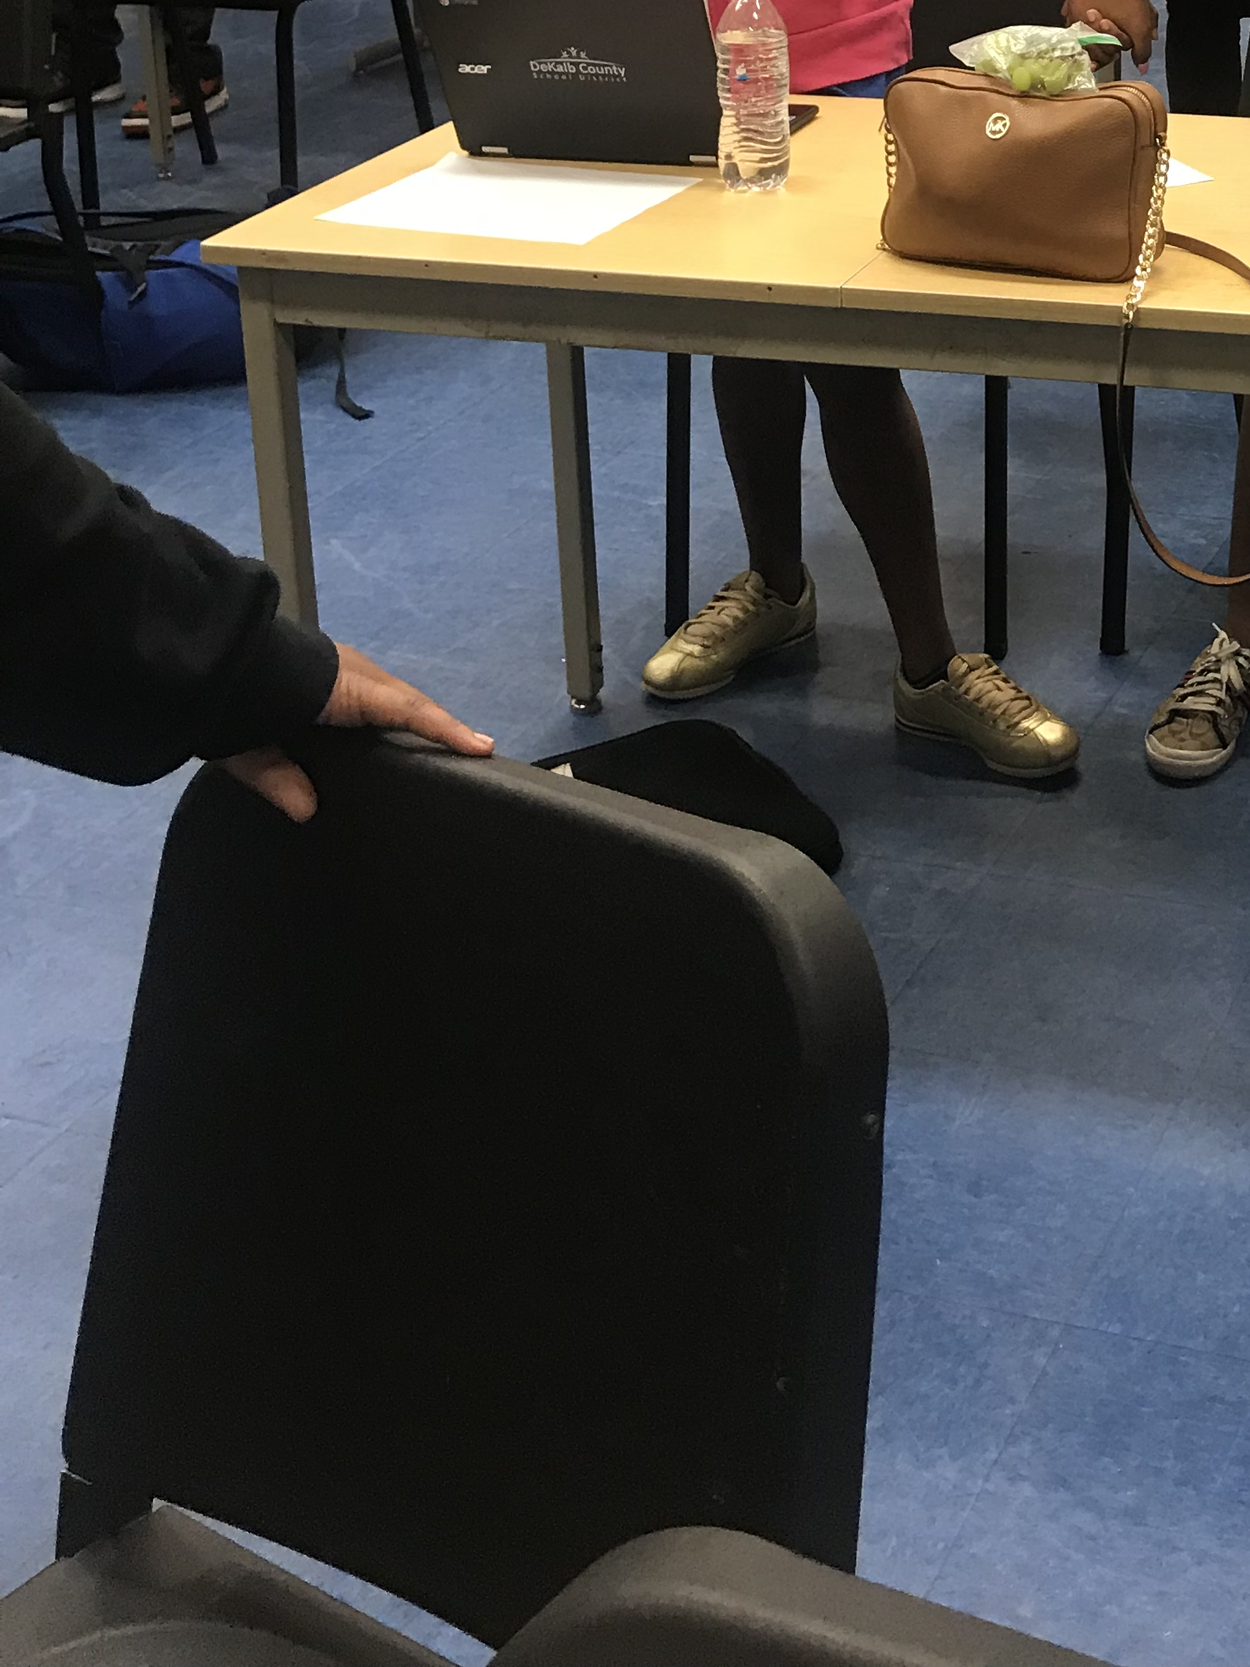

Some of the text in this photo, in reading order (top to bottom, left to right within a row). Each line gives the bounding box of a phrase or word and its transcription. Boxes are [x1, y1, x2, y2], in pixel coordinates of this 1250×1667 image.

[458, 63, 492, 74] acer
[530, 60, 626, 77] DeKalb County
